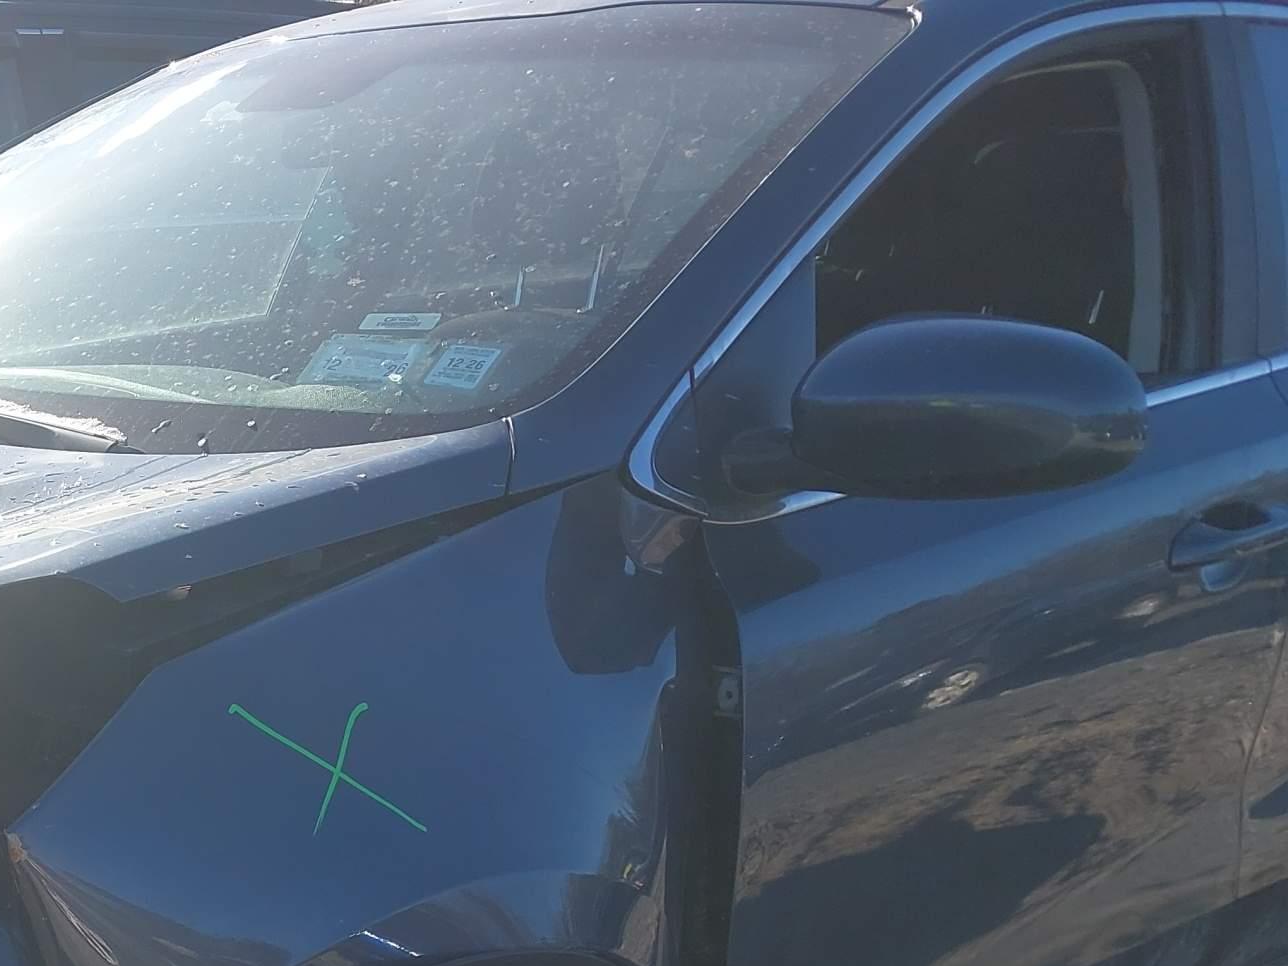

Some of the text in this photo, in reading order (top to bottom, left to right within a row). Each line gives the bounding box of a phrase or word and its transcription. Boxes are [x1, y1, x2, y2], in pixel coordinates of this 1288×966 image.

[323, 357, 342, 371] 12
[447, 357, 487, 370] 12 26
